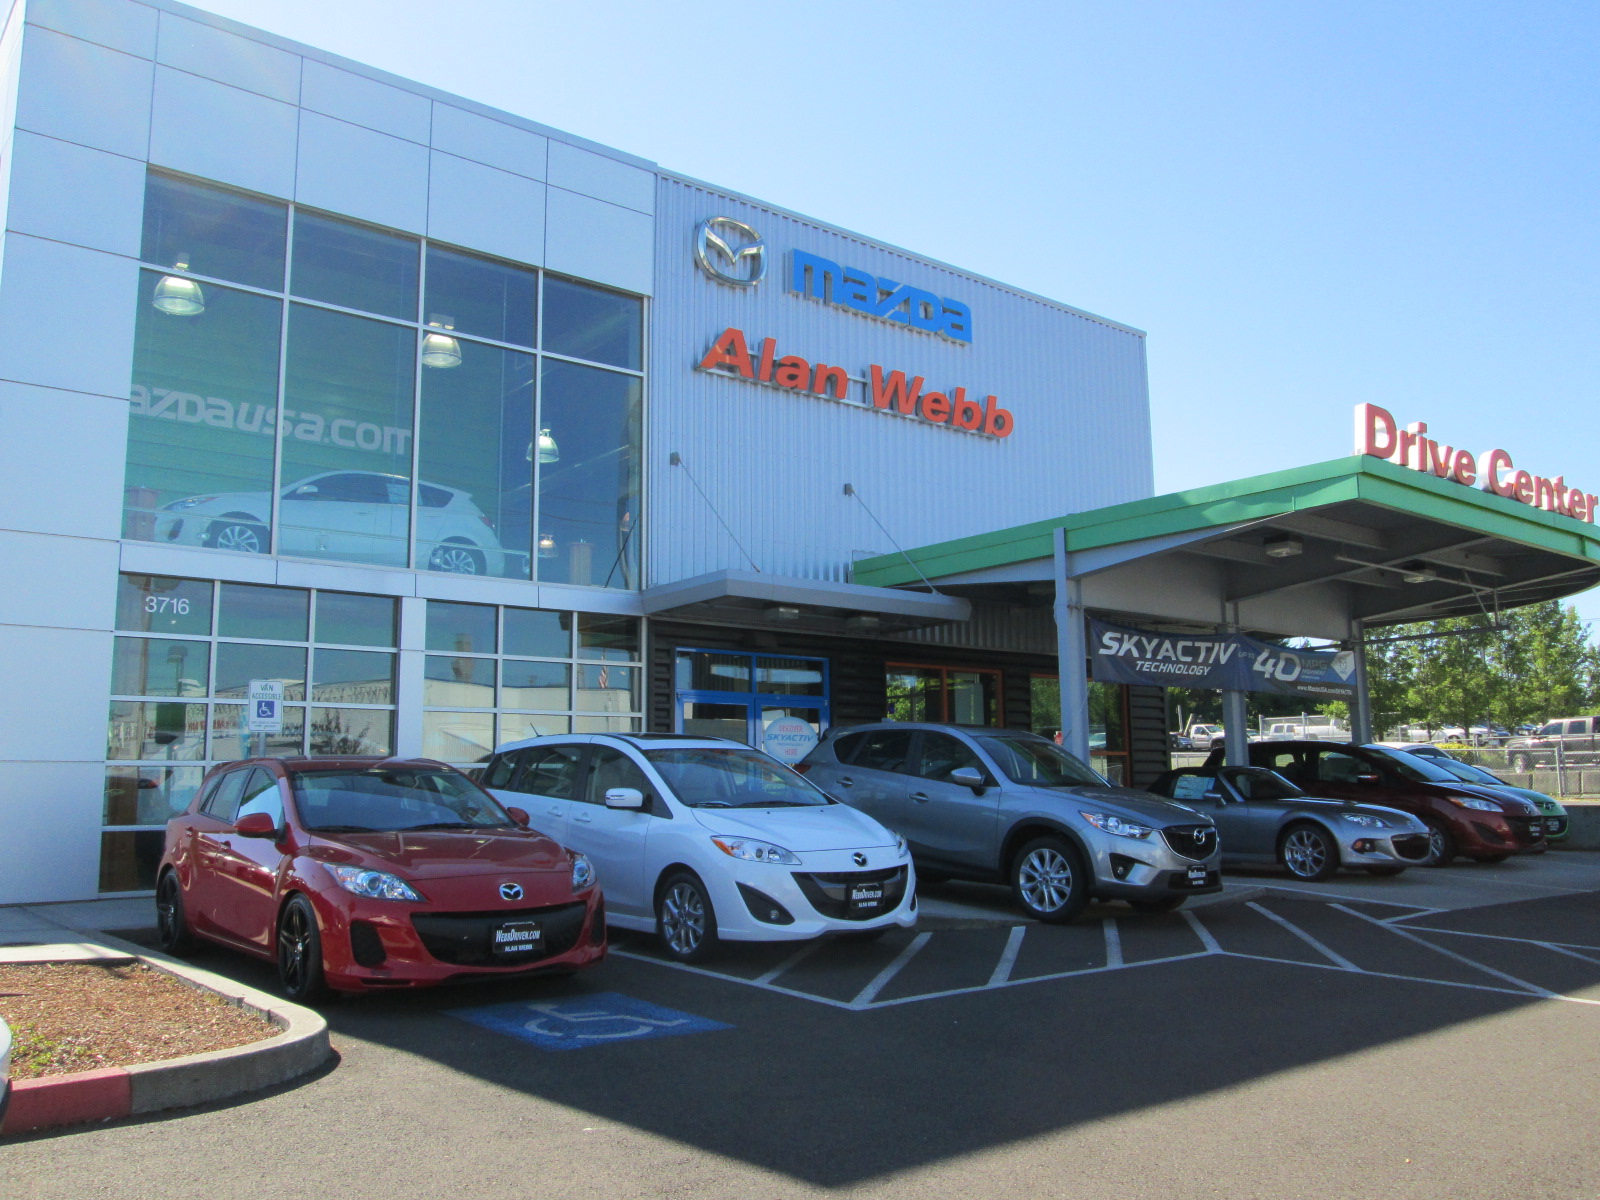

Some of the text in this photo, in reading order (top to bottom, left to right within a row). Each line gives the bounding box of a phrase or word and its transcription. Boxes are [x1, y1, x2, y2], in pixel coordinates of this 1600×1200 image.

[791, 248, 973, 344] mazda
[699, 327, 1014, 439] Alan Webb
[129, 383, 412, 456] azdausa.com
[1356, 402, 1599, 524] Drive Center
[145, 596, 190, 615] 3716
[1098, 631, 1237, 665] SKYACTIV
[1135, 661, 1211, 676] TECHNOLOGY
[1252, 648, 1302, 682] 40
[1301, 658, 1328, 670] MPG
[251, 692, 282, 700] ACCESSIBLE
[260, 684, 274, 692] VAN
[766, 733, 815, 742] SKYACTIV
